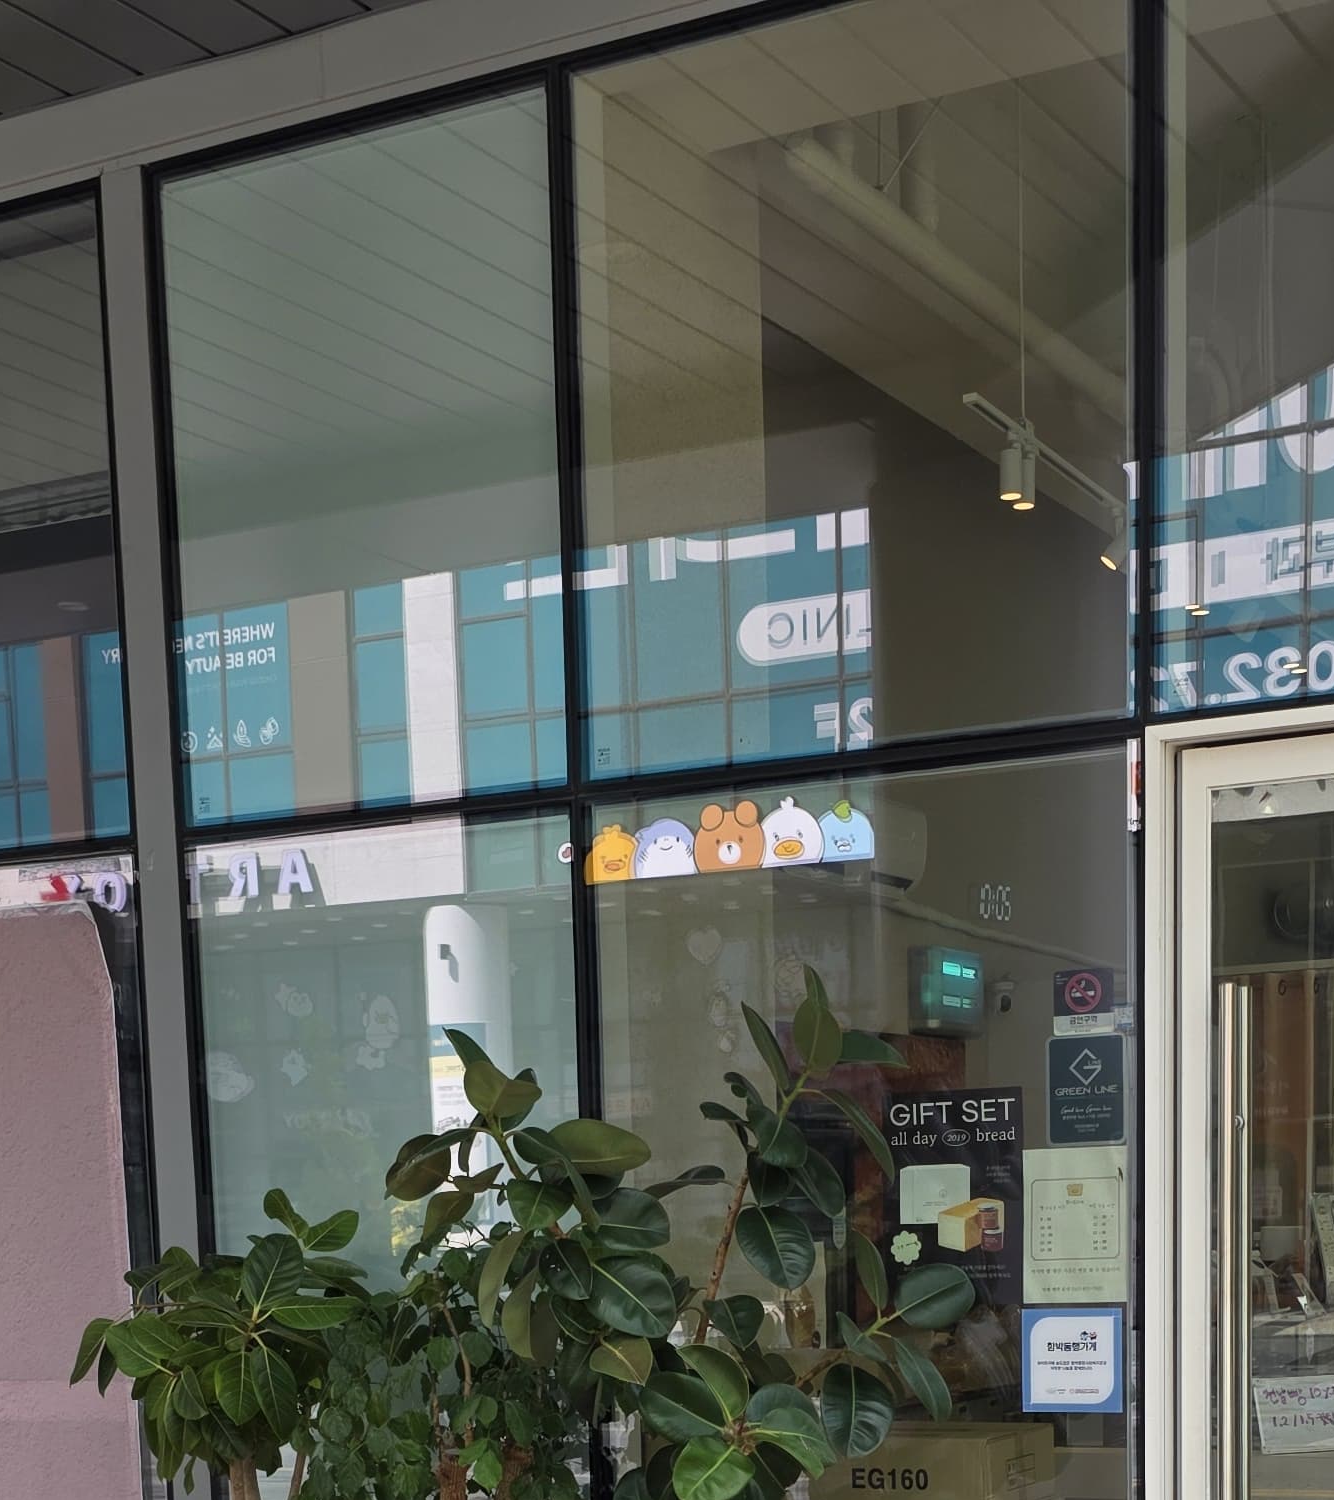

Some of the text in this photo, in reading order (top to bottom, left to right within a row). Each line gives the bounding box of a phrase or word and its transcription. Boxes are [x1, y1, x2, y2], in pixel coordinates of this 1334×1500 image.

[1055, 1087, 1091, 1097] GREEN
[889, 1098, 1016, 1127] GIFT SET
[890, 1126, 1016, 1148] all day 2019 bread
[851, 1468, 929, 1490] EG160
